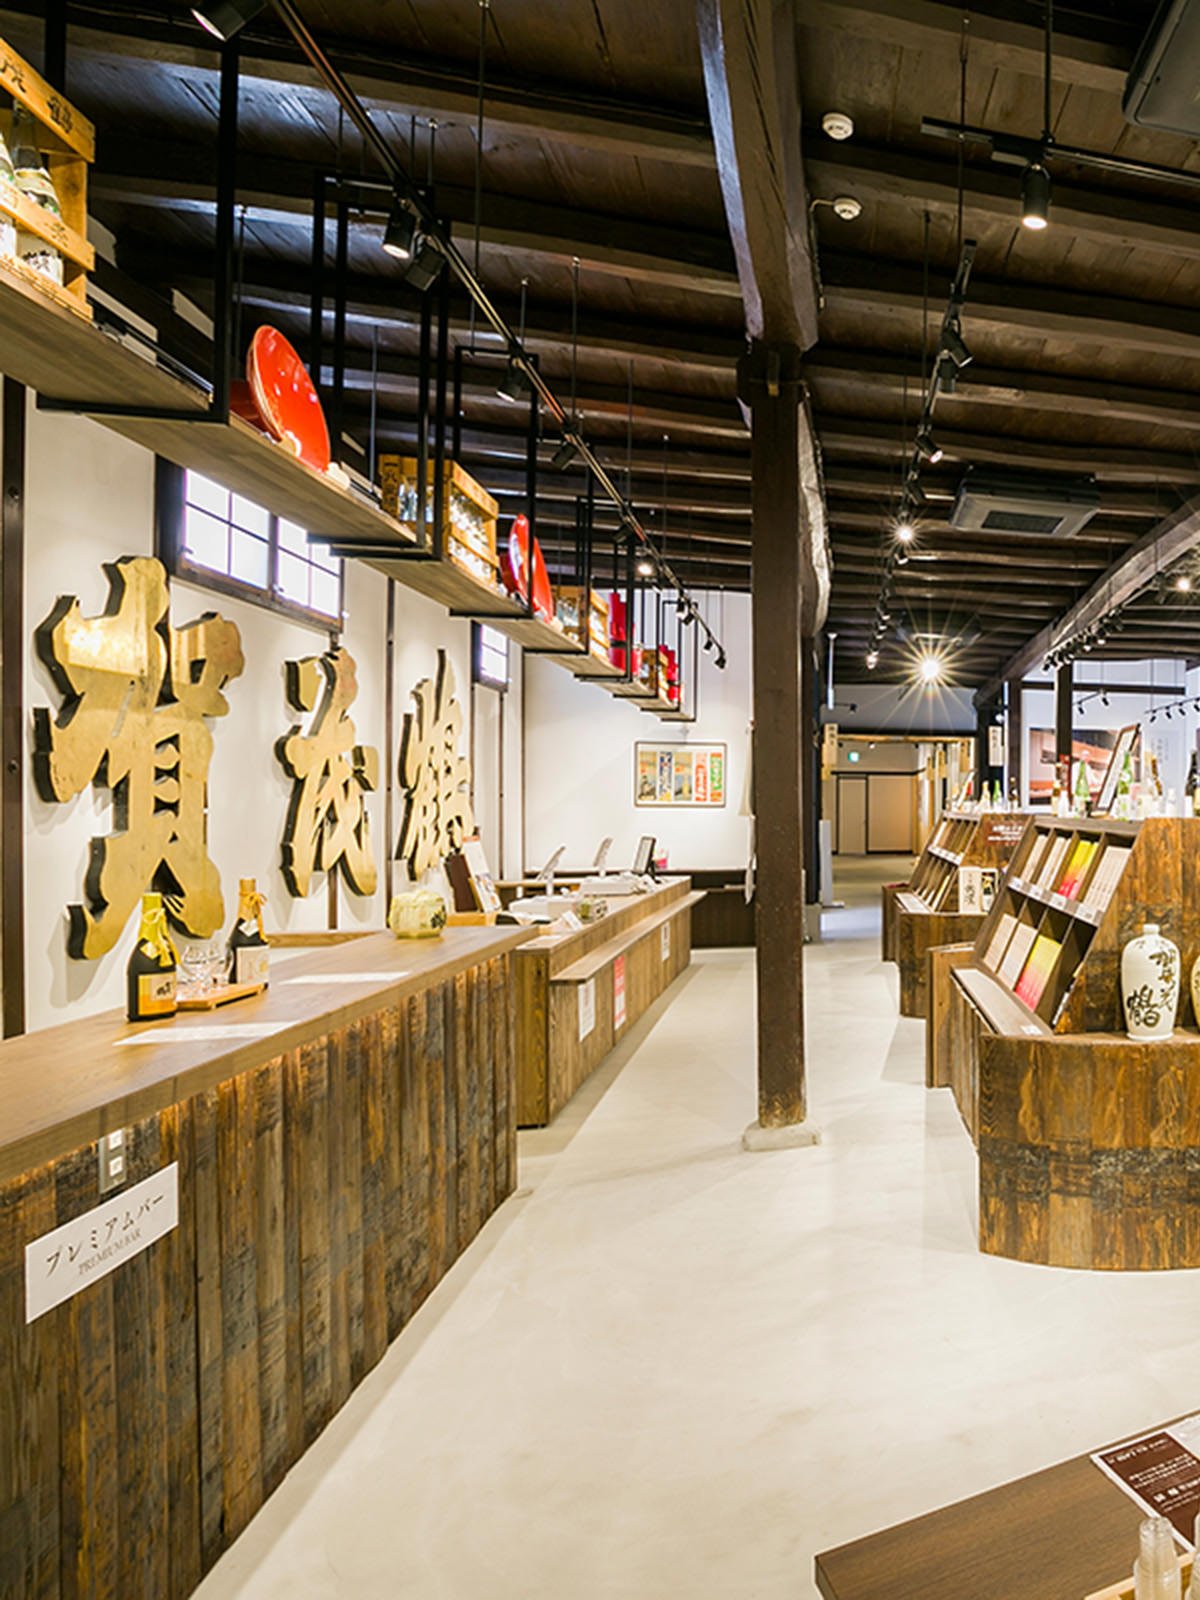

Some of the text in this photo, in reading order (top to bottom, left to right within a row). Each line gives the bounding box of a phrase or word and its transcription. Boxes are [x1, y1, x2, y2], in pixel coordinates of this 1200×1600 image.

[32, 556, 475, 961] 賀茂鶴
[46, 1195, 164, 1278] プレミアムバー
